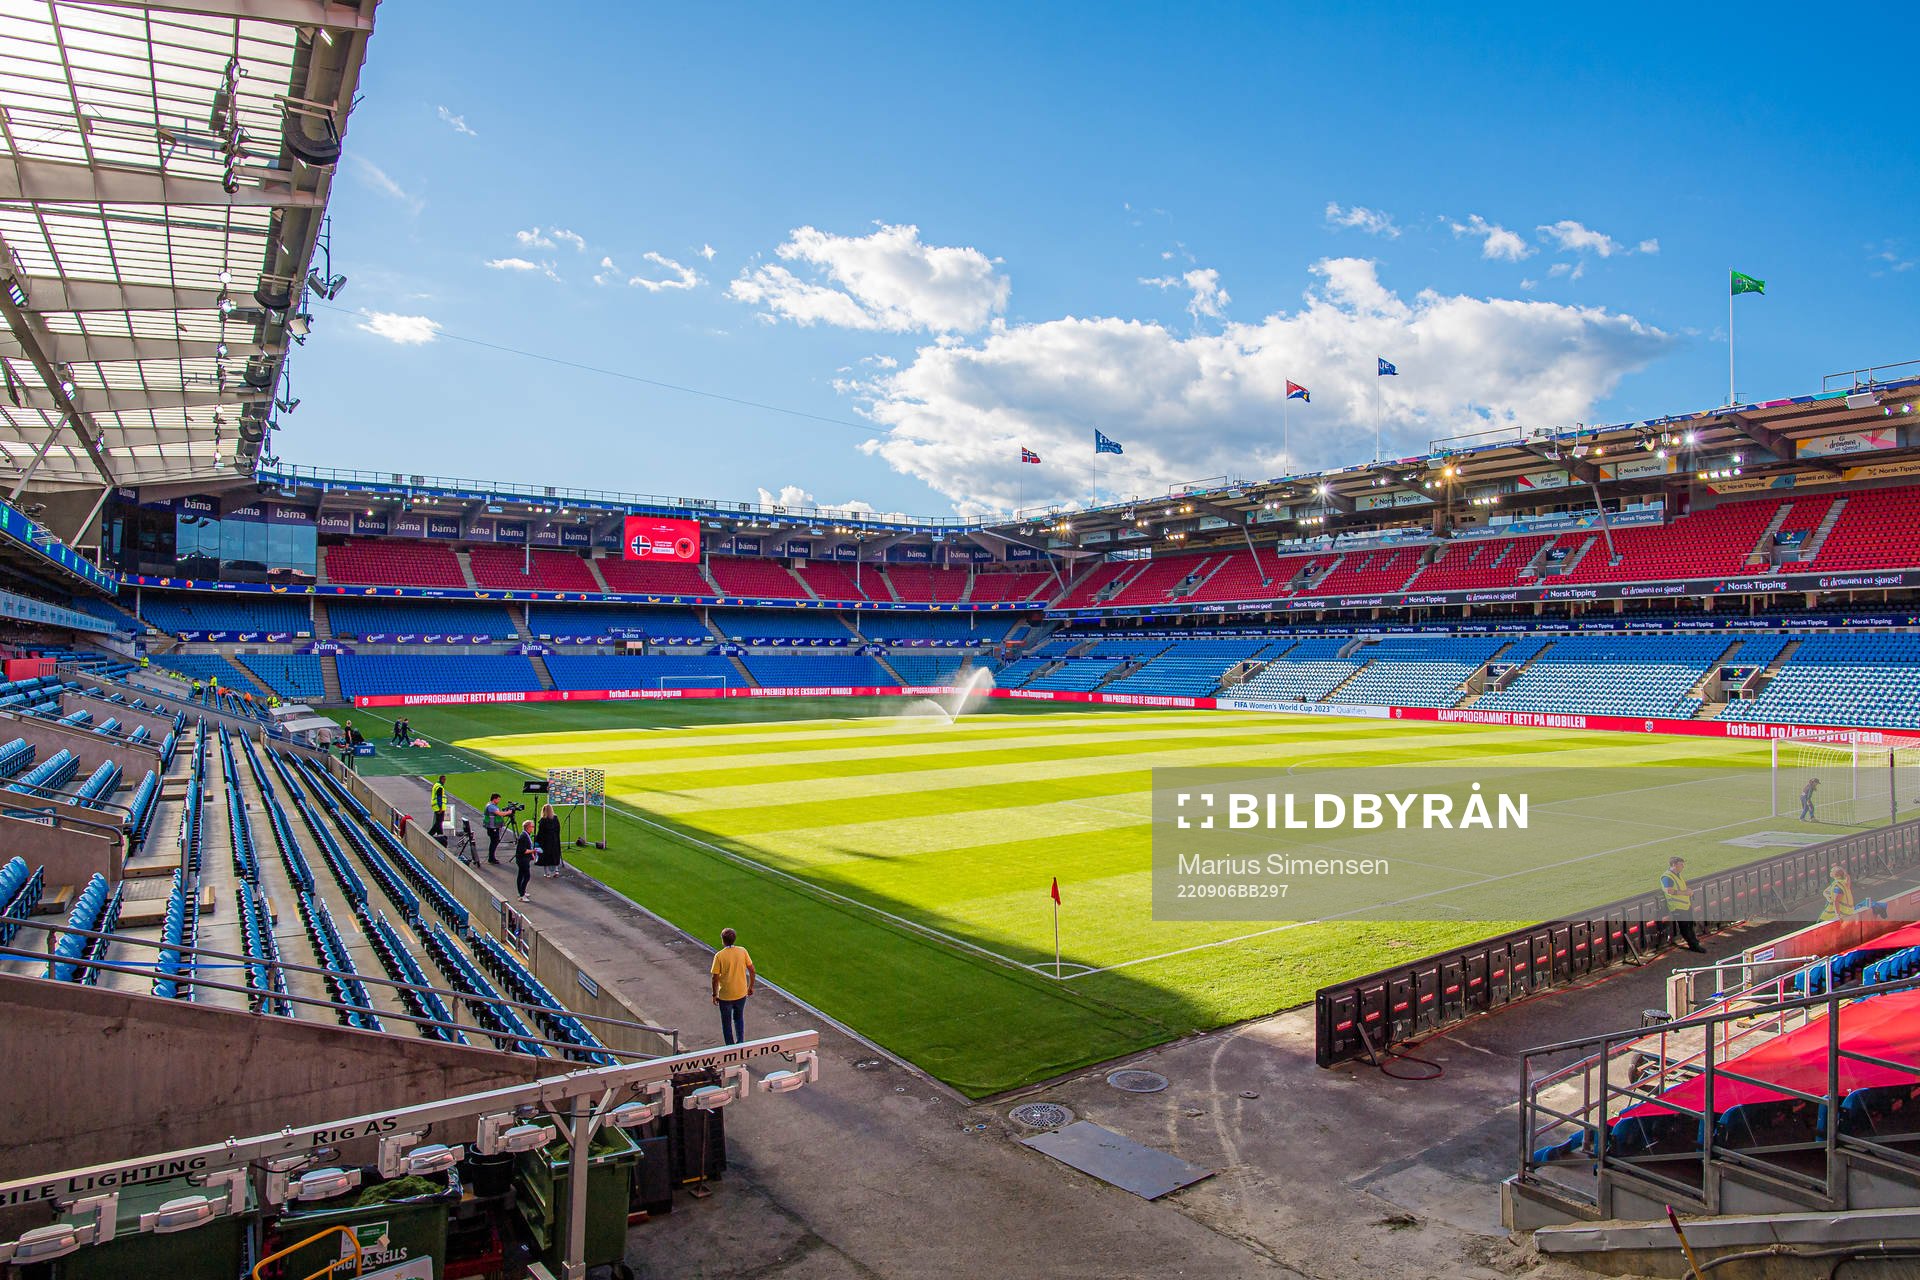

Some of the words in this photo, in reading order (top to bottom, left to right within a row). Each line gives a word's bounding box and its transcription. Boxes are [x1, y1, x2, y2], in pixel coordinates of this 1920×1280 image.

[184, 498, 212, 511] bama
[232, 507, 260, 516] ama
[276, 508, 306, 520] bama
[321, 517, 349, 527] bama
[359, 519, 386, 530] bama
[432, 523, 457, 533] bama
[470, 526, 490, 535] ama
[500, 528, 524, 537] bama
[536, 530, 556, 539] ama
[565, 533, 588, 541] bama
[738, 542, 758, 550] bama
[838, 548, 856, 556] bama
[907, 550, 926, 558] bama
[1728, 582, 1752, 591] Norsk
[1753, 581, 1787, 591] Tipping
[1550, 590, 1570, 598] Norsk
[1570, 589, 1596, 598] Tipping
[1426, 596, 1447, 604] Tipping
[314, 642, 338, 650] bama
[522, 643, 542, 651] bama
[404, 694, 469, 704] KAMPPROGRAMMET
[470, 693, 486, 702] RETT
[496, 692, 525, 701] MOBILEN
[1234, 701, 1248, 710] FIFA
[1250, 702, 1277, 711] Women's
[1279, 703, 1298, 712] World
[1300, 704, 1313, 714] Cup
[1337, 706, 1367, 716] Qualifiers
[1438, 710, 1511, 724] KAMPPROGRAMMET
[1513, 713, 1532, 725] RETT
[1546, 715, 1586, 728] MOBILEN
[670, 1044, 780, 1072] www.mlr.no
[313, 1128, 355, 1145] RIG
[364, 1117, 397, 1135] AS
[69, 1156, 206, 1193] LIGHTING
[375, 1247, 408, 1264] SELLS
